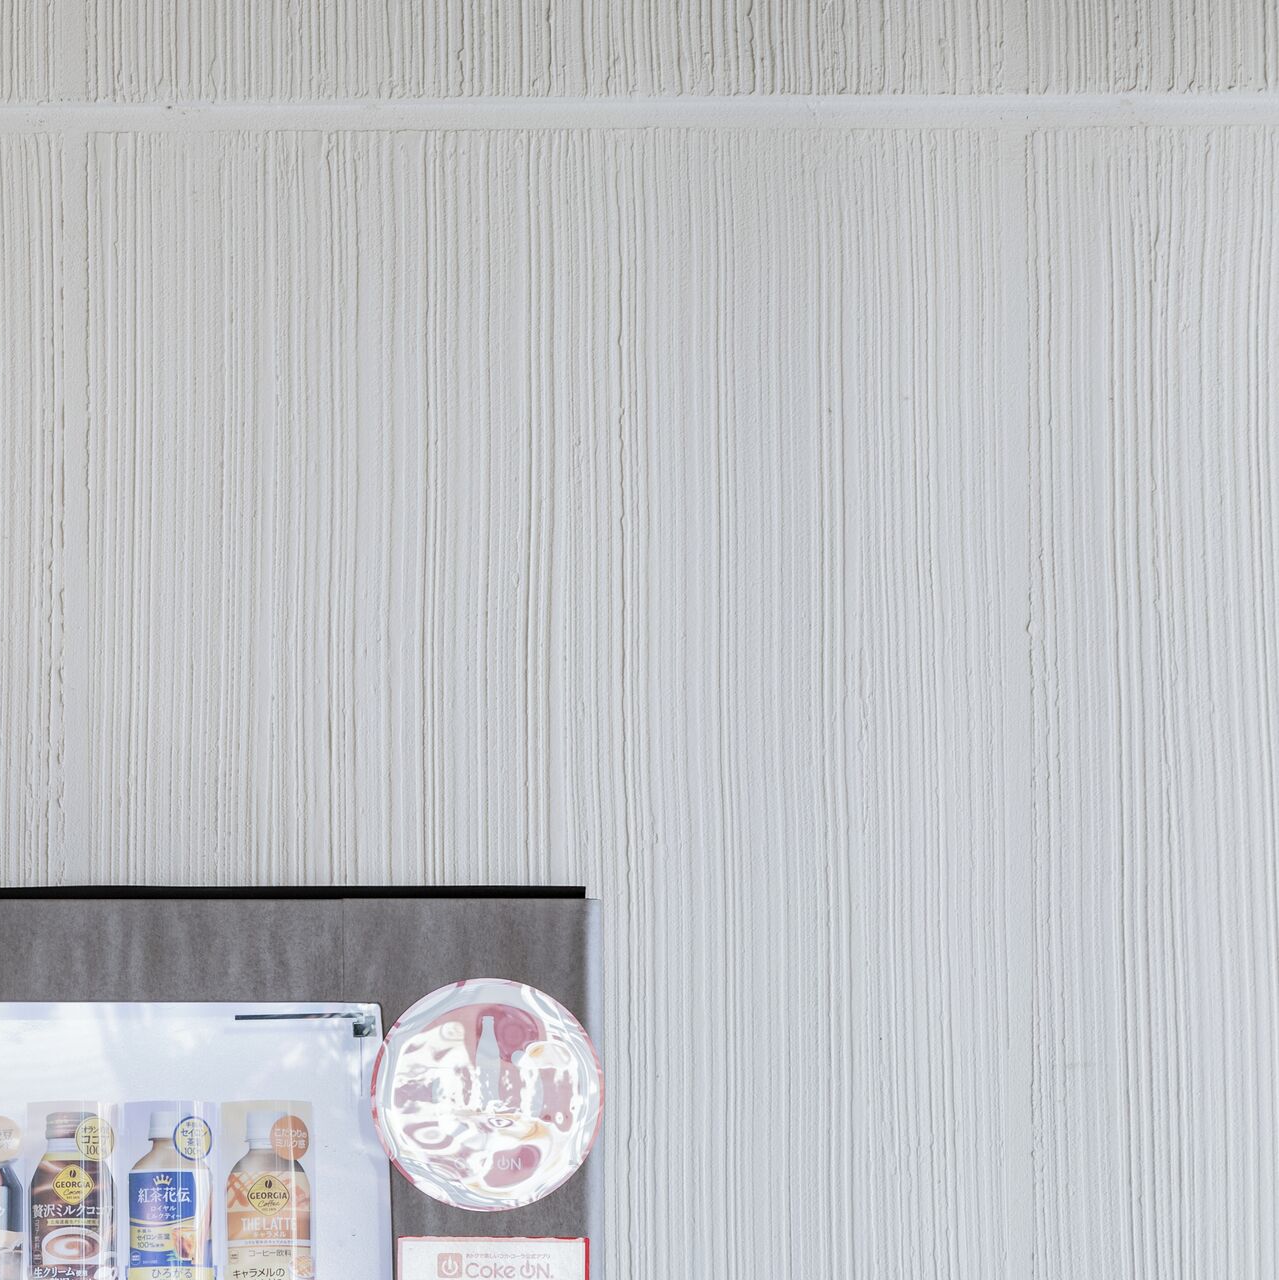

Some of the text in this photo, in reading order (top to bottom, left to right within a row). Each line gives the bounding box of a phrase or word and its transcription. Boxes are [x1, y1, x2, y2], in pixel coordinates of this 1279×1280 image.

[138, 1187, 191, 1204] 紅茶花伝
[250, 1191, 288, 1200] GEORGIA
[232, 1268, 286, 1278] キャラメルの
[465, 1263, 516, 1279] Coke
